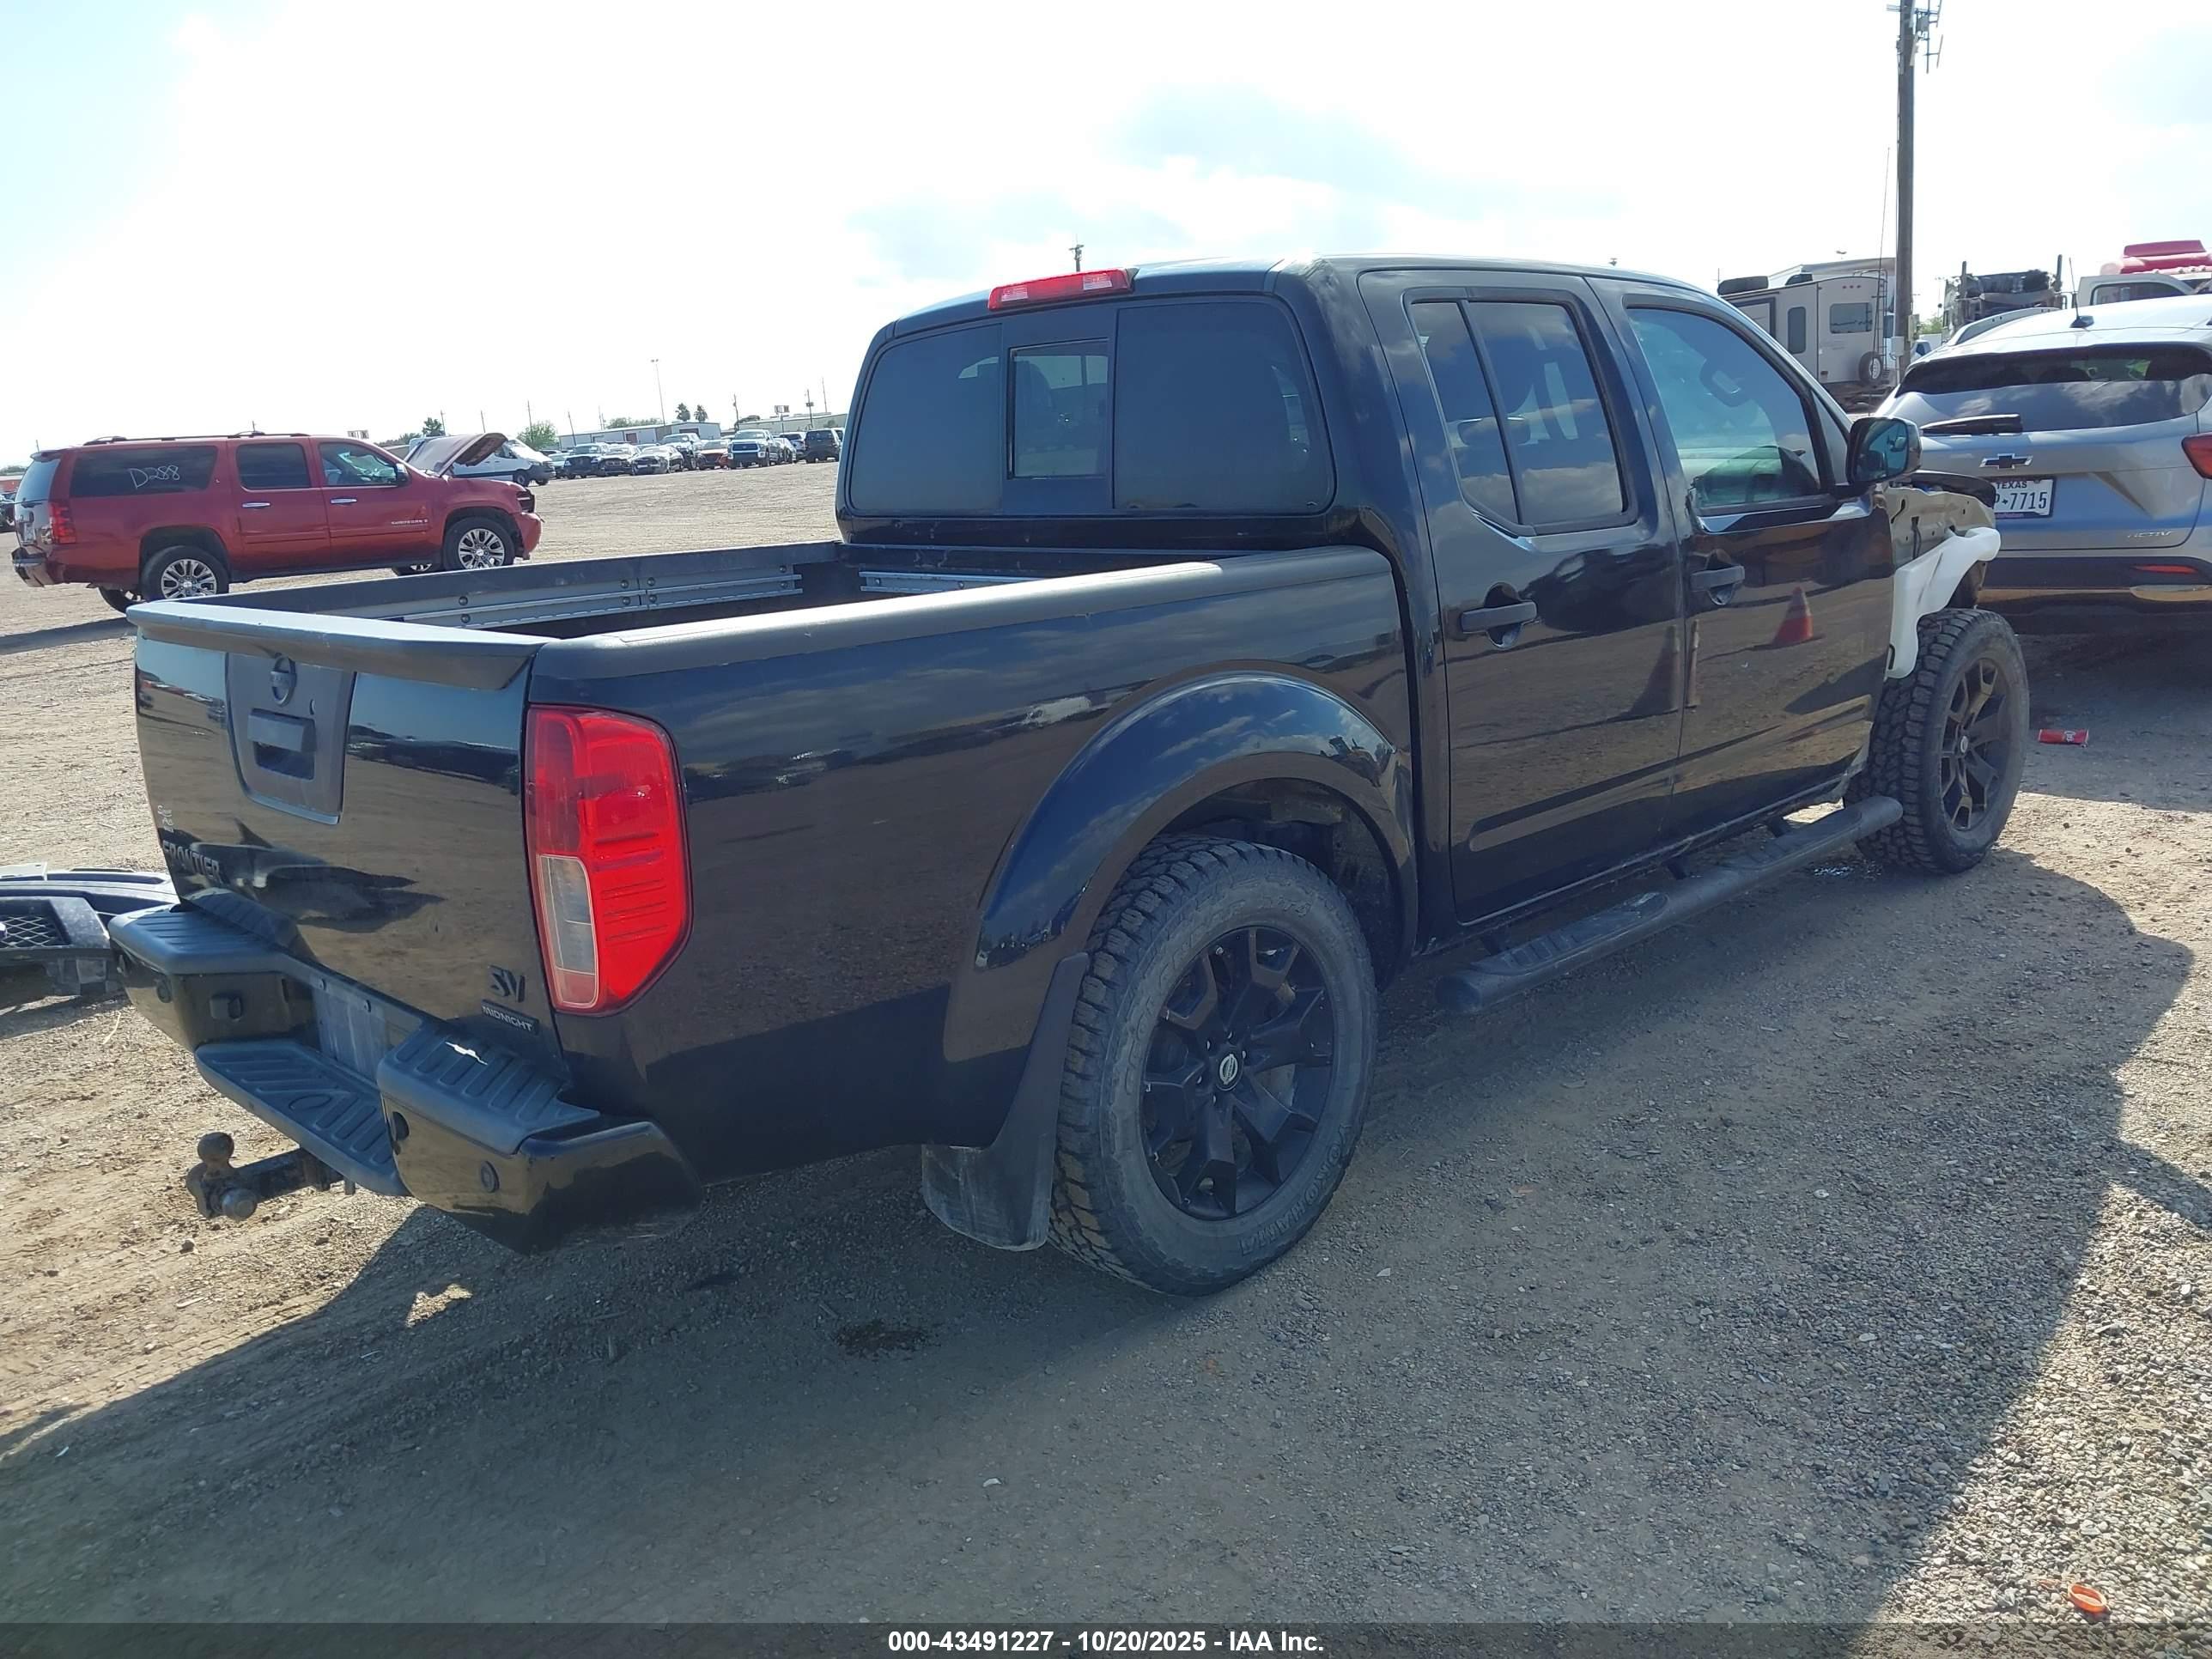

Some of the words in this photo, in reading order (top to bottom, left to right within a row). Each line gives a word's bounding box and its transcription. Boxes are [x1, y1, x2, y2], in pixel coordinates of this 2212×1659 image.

[129, 465, 180, 489] D288
[1996, 481, 2027, 489] TEXAS
[163, 840, 223, 885] FRONTIER
[488, 964, 526, 1004] SV
[482, 1006, 533, 1031] MIDNIGHT
[1238, 1123, 1354, 1256] YOKOHAMA
